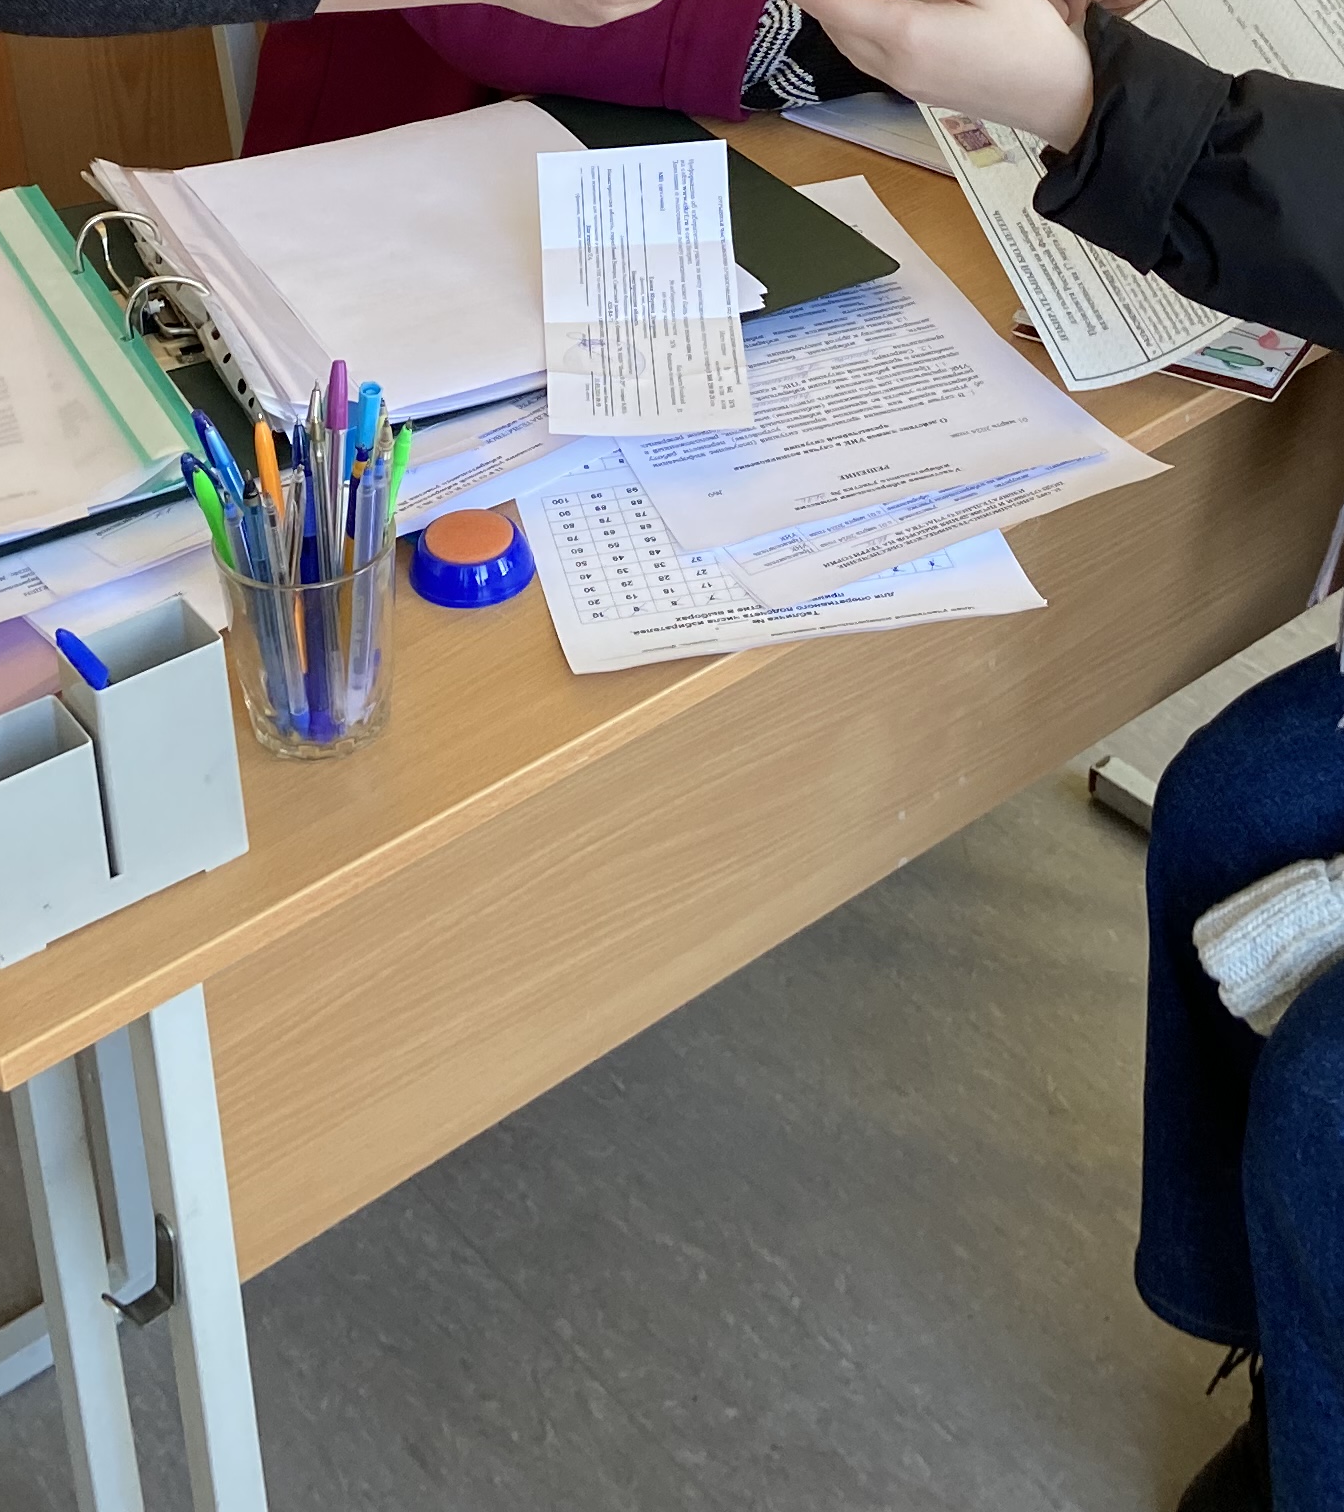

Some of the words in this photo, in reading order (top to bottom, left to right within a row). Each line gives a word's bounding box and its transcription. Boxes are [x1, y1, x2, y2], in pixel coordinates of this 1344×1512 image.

[551, 497, 569, 505] 100
[602, 528, 615, 536] 69
[689, 554, 703, 563] 37
[578, 572, 592, 580] 40
[694, 567, 708, 577] 27
[699, 580, 713, 589] 17
[582, 585, 596, 593] 30
[624, 592, 638, 600] 19
[587, 598, 600, 606] 20
